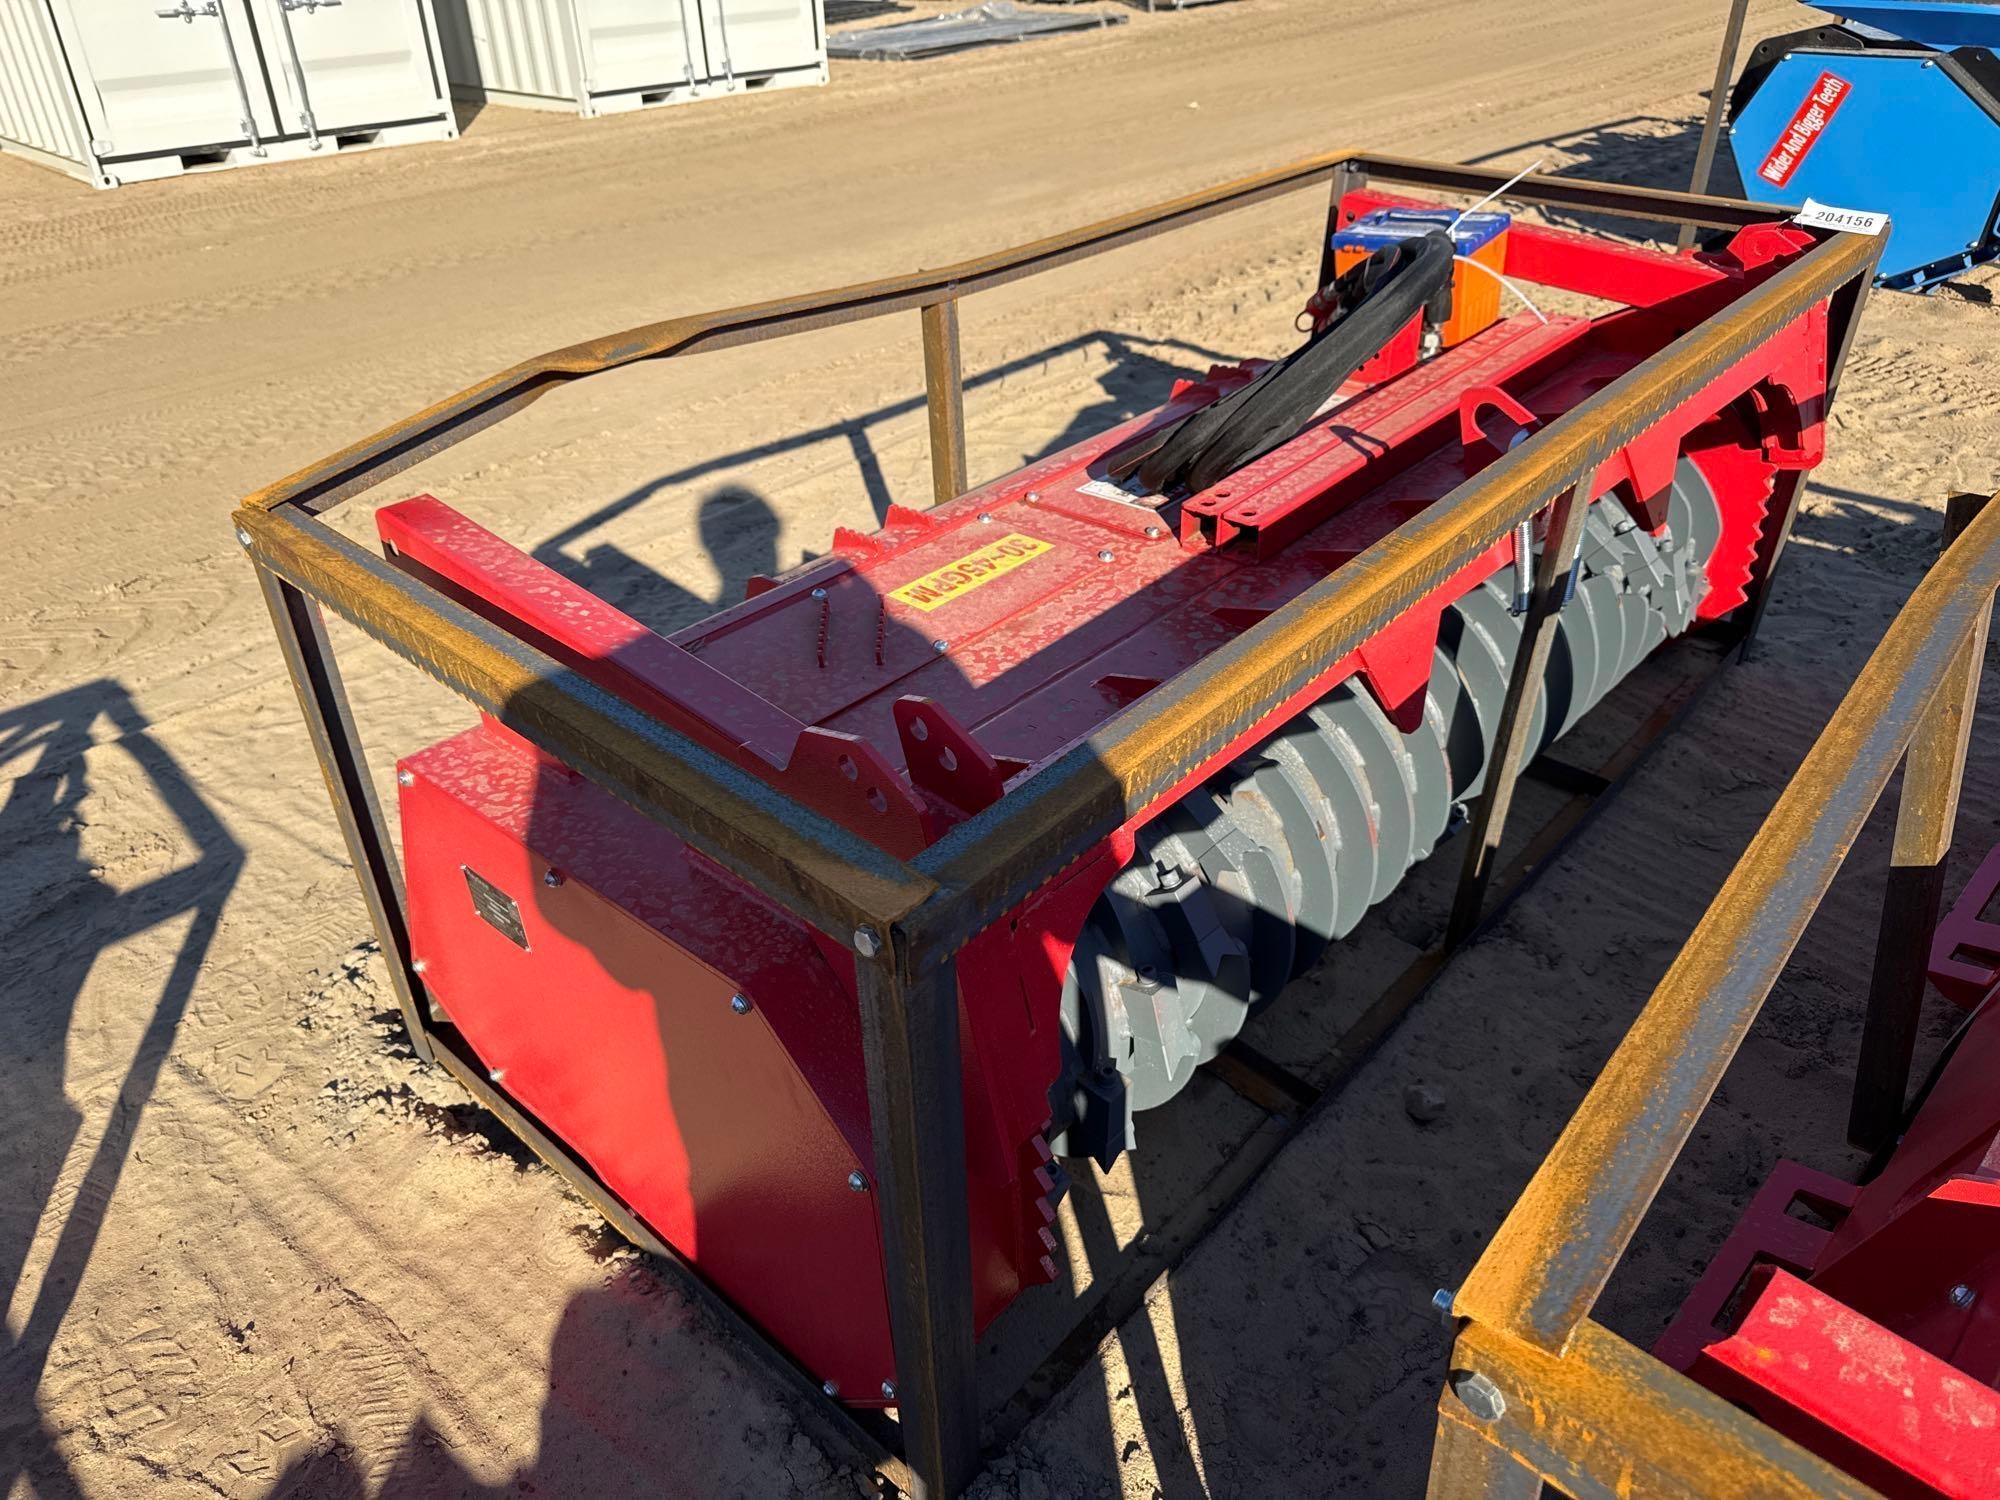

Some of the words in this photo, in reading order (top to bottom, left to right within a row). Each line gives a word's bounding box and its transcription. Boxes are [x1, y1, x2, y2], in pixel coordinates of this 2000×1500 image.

[1812, 77, 1844, 106] Teeth
[1793, 103, 1826, 137] Bigger
[1782, 129, 1807, 155] And
[1762, 151, 1794, 181] Wider
[1815, 211, 1874, 228] 204156
